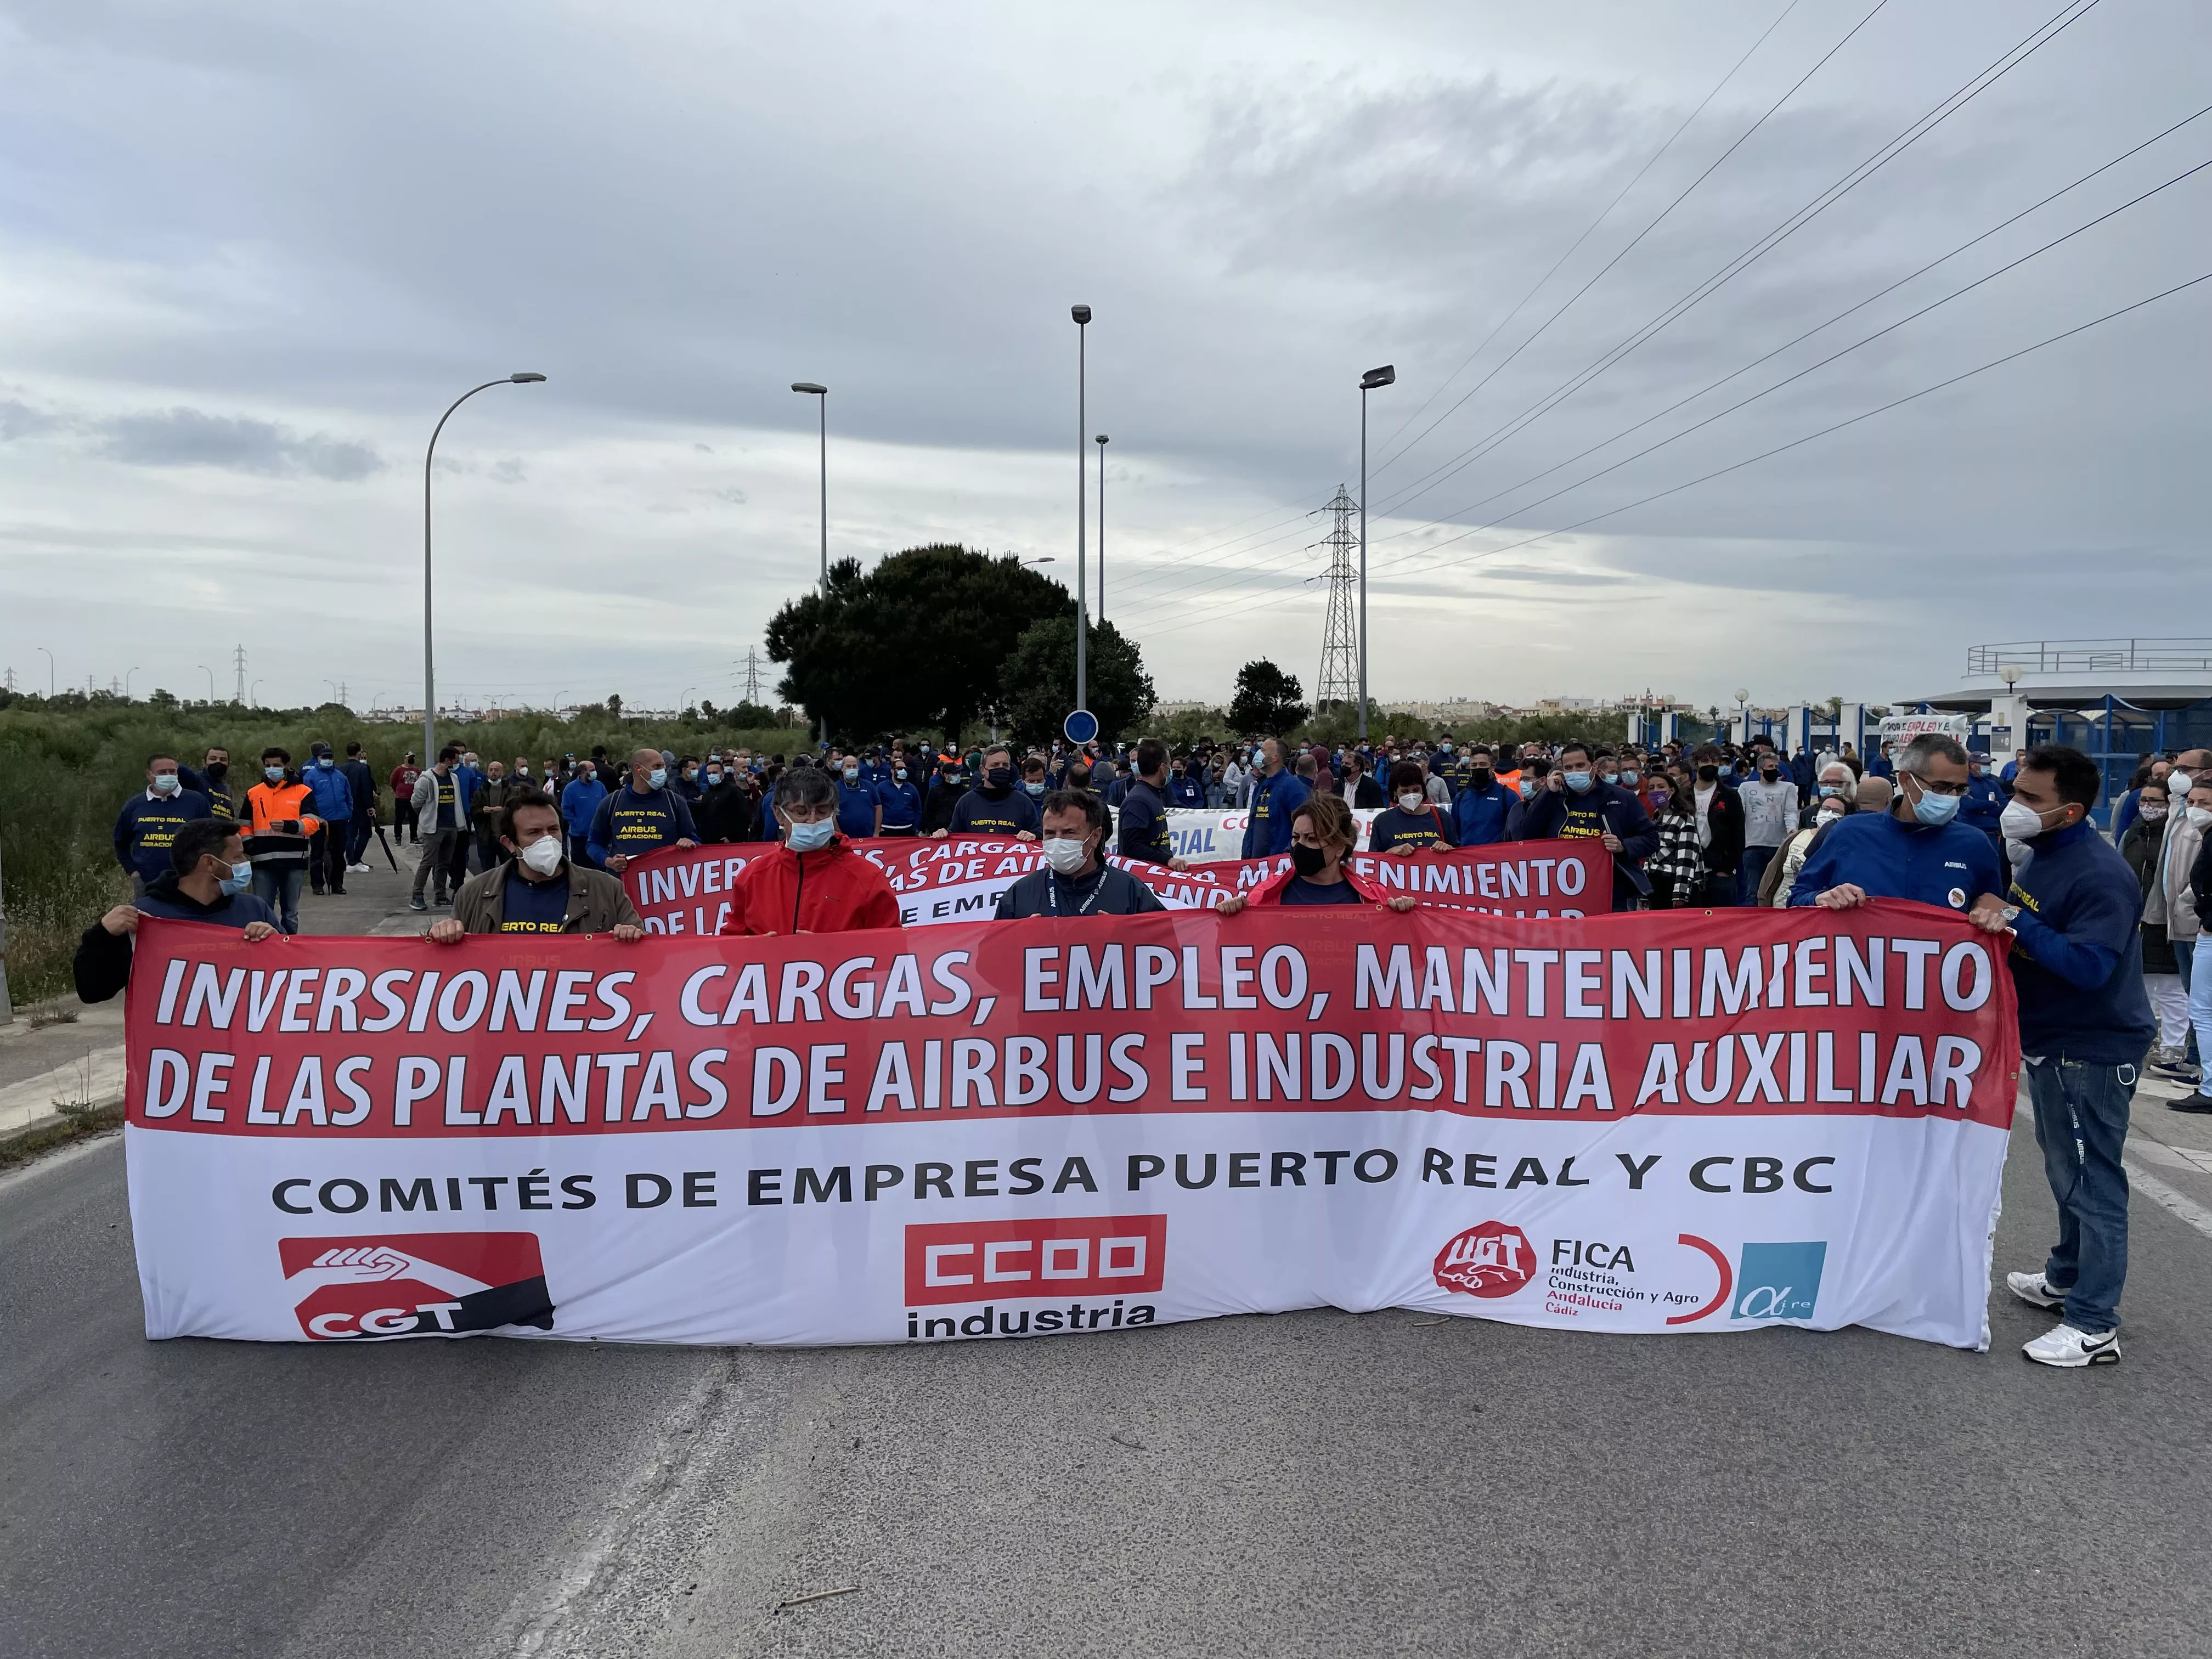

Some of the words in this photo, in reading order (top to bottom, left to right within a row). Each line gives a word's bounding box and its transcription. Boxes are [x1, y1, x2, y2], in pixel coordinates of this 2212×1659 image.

[1394, 832, 1423, 840] PUERTO
[1562, 825, 1600, 836] AIRBUS
[1098, 870, 1108, 889] AIRBUS
[1944, 861, 1967, 870] AIRBUS
[695, 901, 732, 936] LA
[938, 857, 987, 885] DE
[1079, 893, 1095, 914] AIRBUS
[501, 922, 537, 931] ERTO
[155, 958, 655, 1042] INVERSIONES,
[679, 950, 998, 1028] CARGAS,
[1023, 943, 1332, 1022] EMPLEO,
[1354, 935, 1993, 1020] MANTENIMIENTO
[144, 1047, 236, 1122] DE
[245, 1054, 374, 1127] LAS
[393, 1047, 730, 1128] PLANTAS
[751, 1043, 847, 1118] DE
[865, 1032, 1151, 1112] AIRBUS
[1170, 1031, 1207, 1102] E
[1228, 1031, 1616, 1111] INDUSTRIA
[1634, 1030, 1983, 1110] AUXILIAR
[272, 1168, 596, 1214] COMITÉS
[625, 1171, 718, 1209] DE
[747, 1156, 1098, 1206] EMPRESA
[1127, 1148, 1398, 1191] PUERTO
[1422, 1147, 1590, 1189] REAL
[1615, 1153, 1662, 1189] Y
[1689, 1156, 1836, 1194] CBC
[925, 1235, 1148, 1288] CCOO
[1445, 1233, 1522, 1268] UGT
[1551, 1239, 1635, 1273] FICA
[1547, 1290, 1623, 1311] Andalucía
[1548, 1276, 1645, 1301] Construcción
[1650, 1293, 1659, 1304] y
[1663, 1291, 1699, 1305] Agro
[308, 1301, 462, 1338] CGT
[907, 1300, 1155, 1339] industria
[1545, 1302, 1578, 1316] Cádiz
